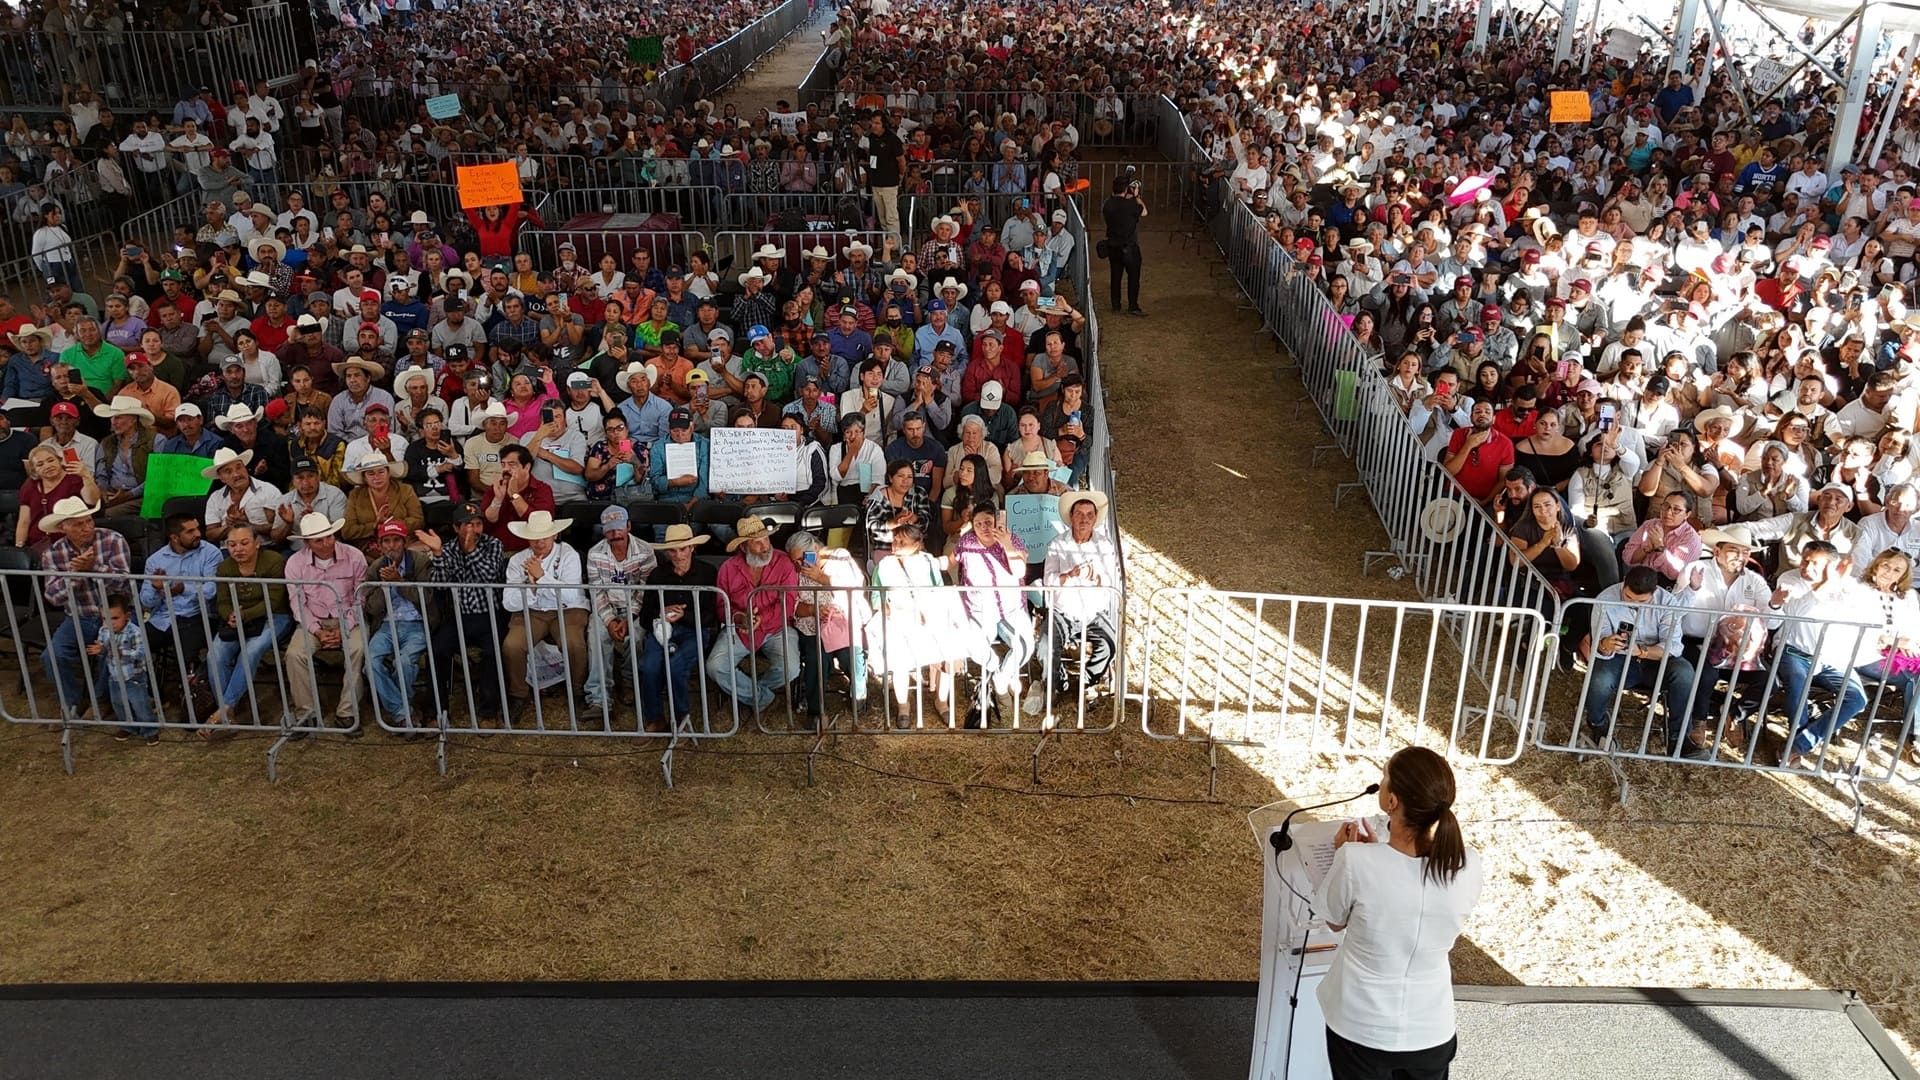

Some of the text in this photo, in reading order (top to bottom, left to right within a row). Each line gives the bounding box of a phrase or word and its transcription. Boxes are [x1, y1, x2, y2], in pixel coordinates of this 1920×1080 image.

[1752, 173, 1776, 181] NORTH
[385, 311, 416, 319] Champion
[1012, 501, 1058, 515] Cosechand
